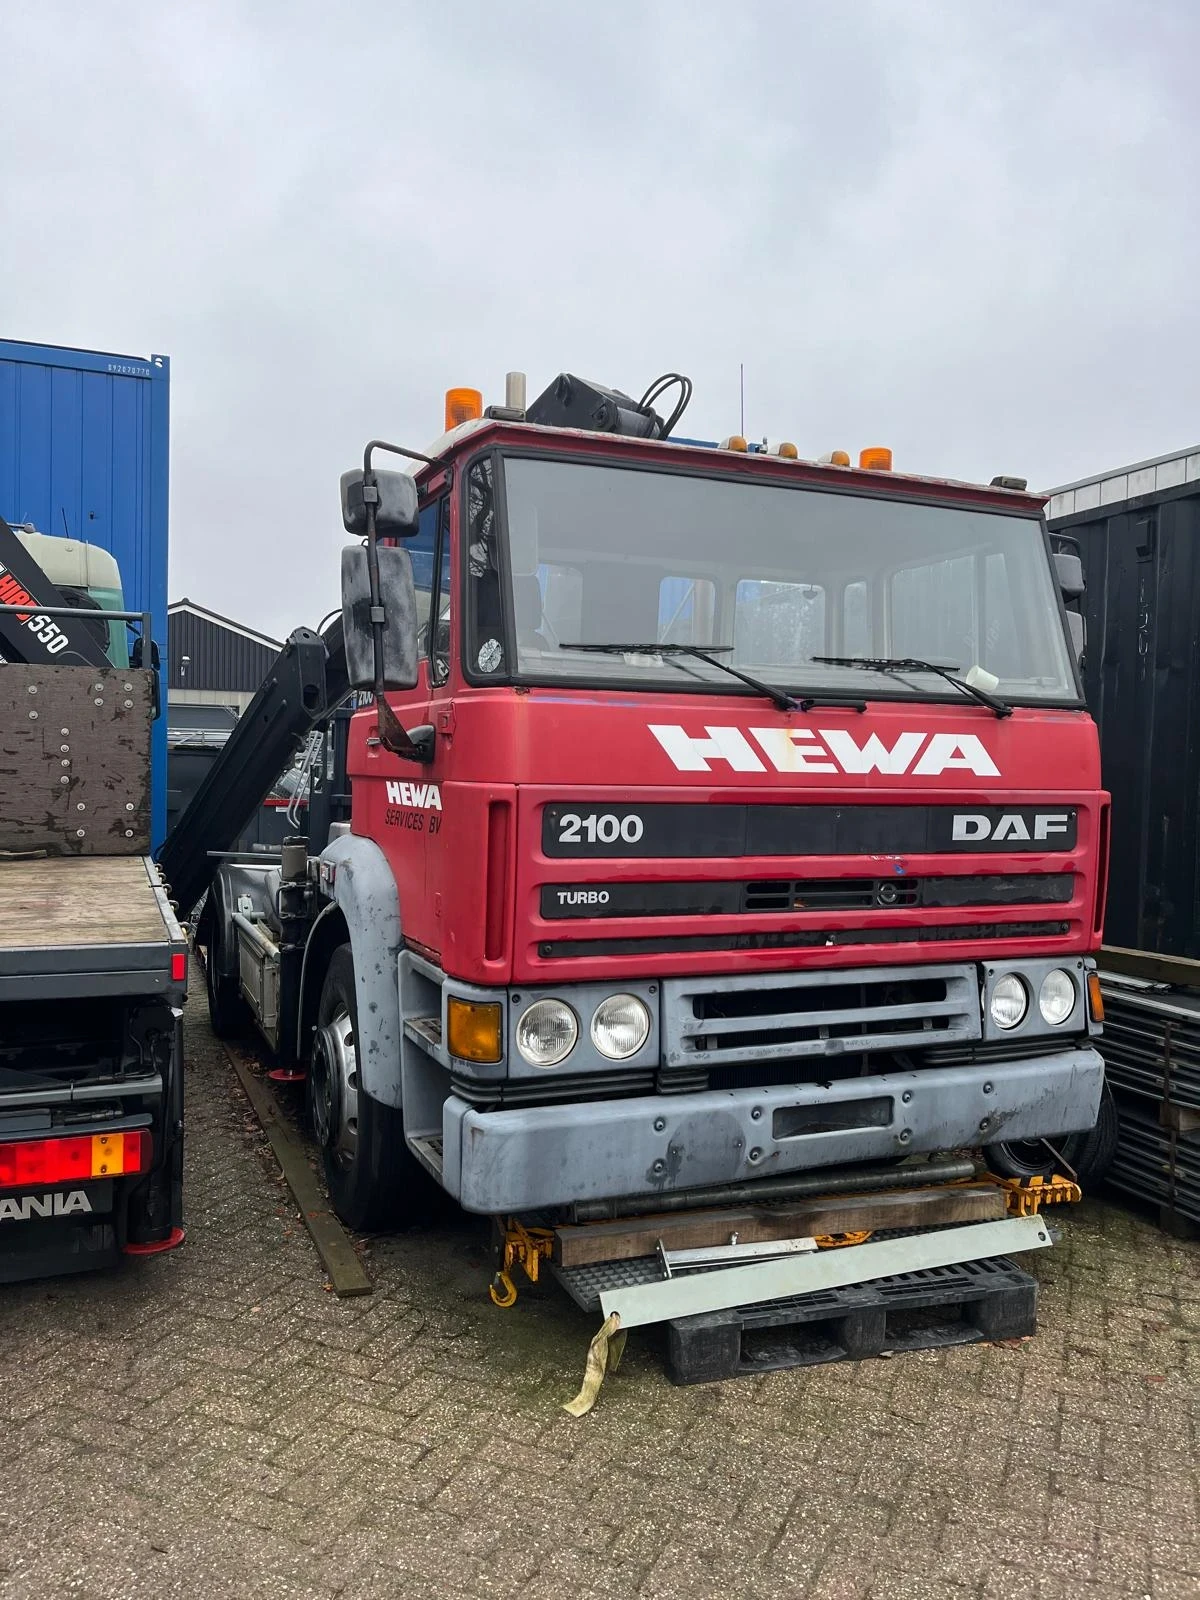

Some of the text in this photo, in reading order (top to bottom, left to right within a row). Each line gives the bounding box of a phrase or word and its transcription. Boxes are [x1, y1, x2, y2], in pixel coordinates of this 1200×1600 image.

[27, 615, 69, 654] 550
[647, 724, 1002, 777] HEWA
[385, 780, 443, 811] HEWA
[385, 808, 442, 834] SERVICES BV
[558, 813, 644, 843] 2100
[951, 814, 1069, 841] DAF
[557, 891, 610, 904] TURBO
